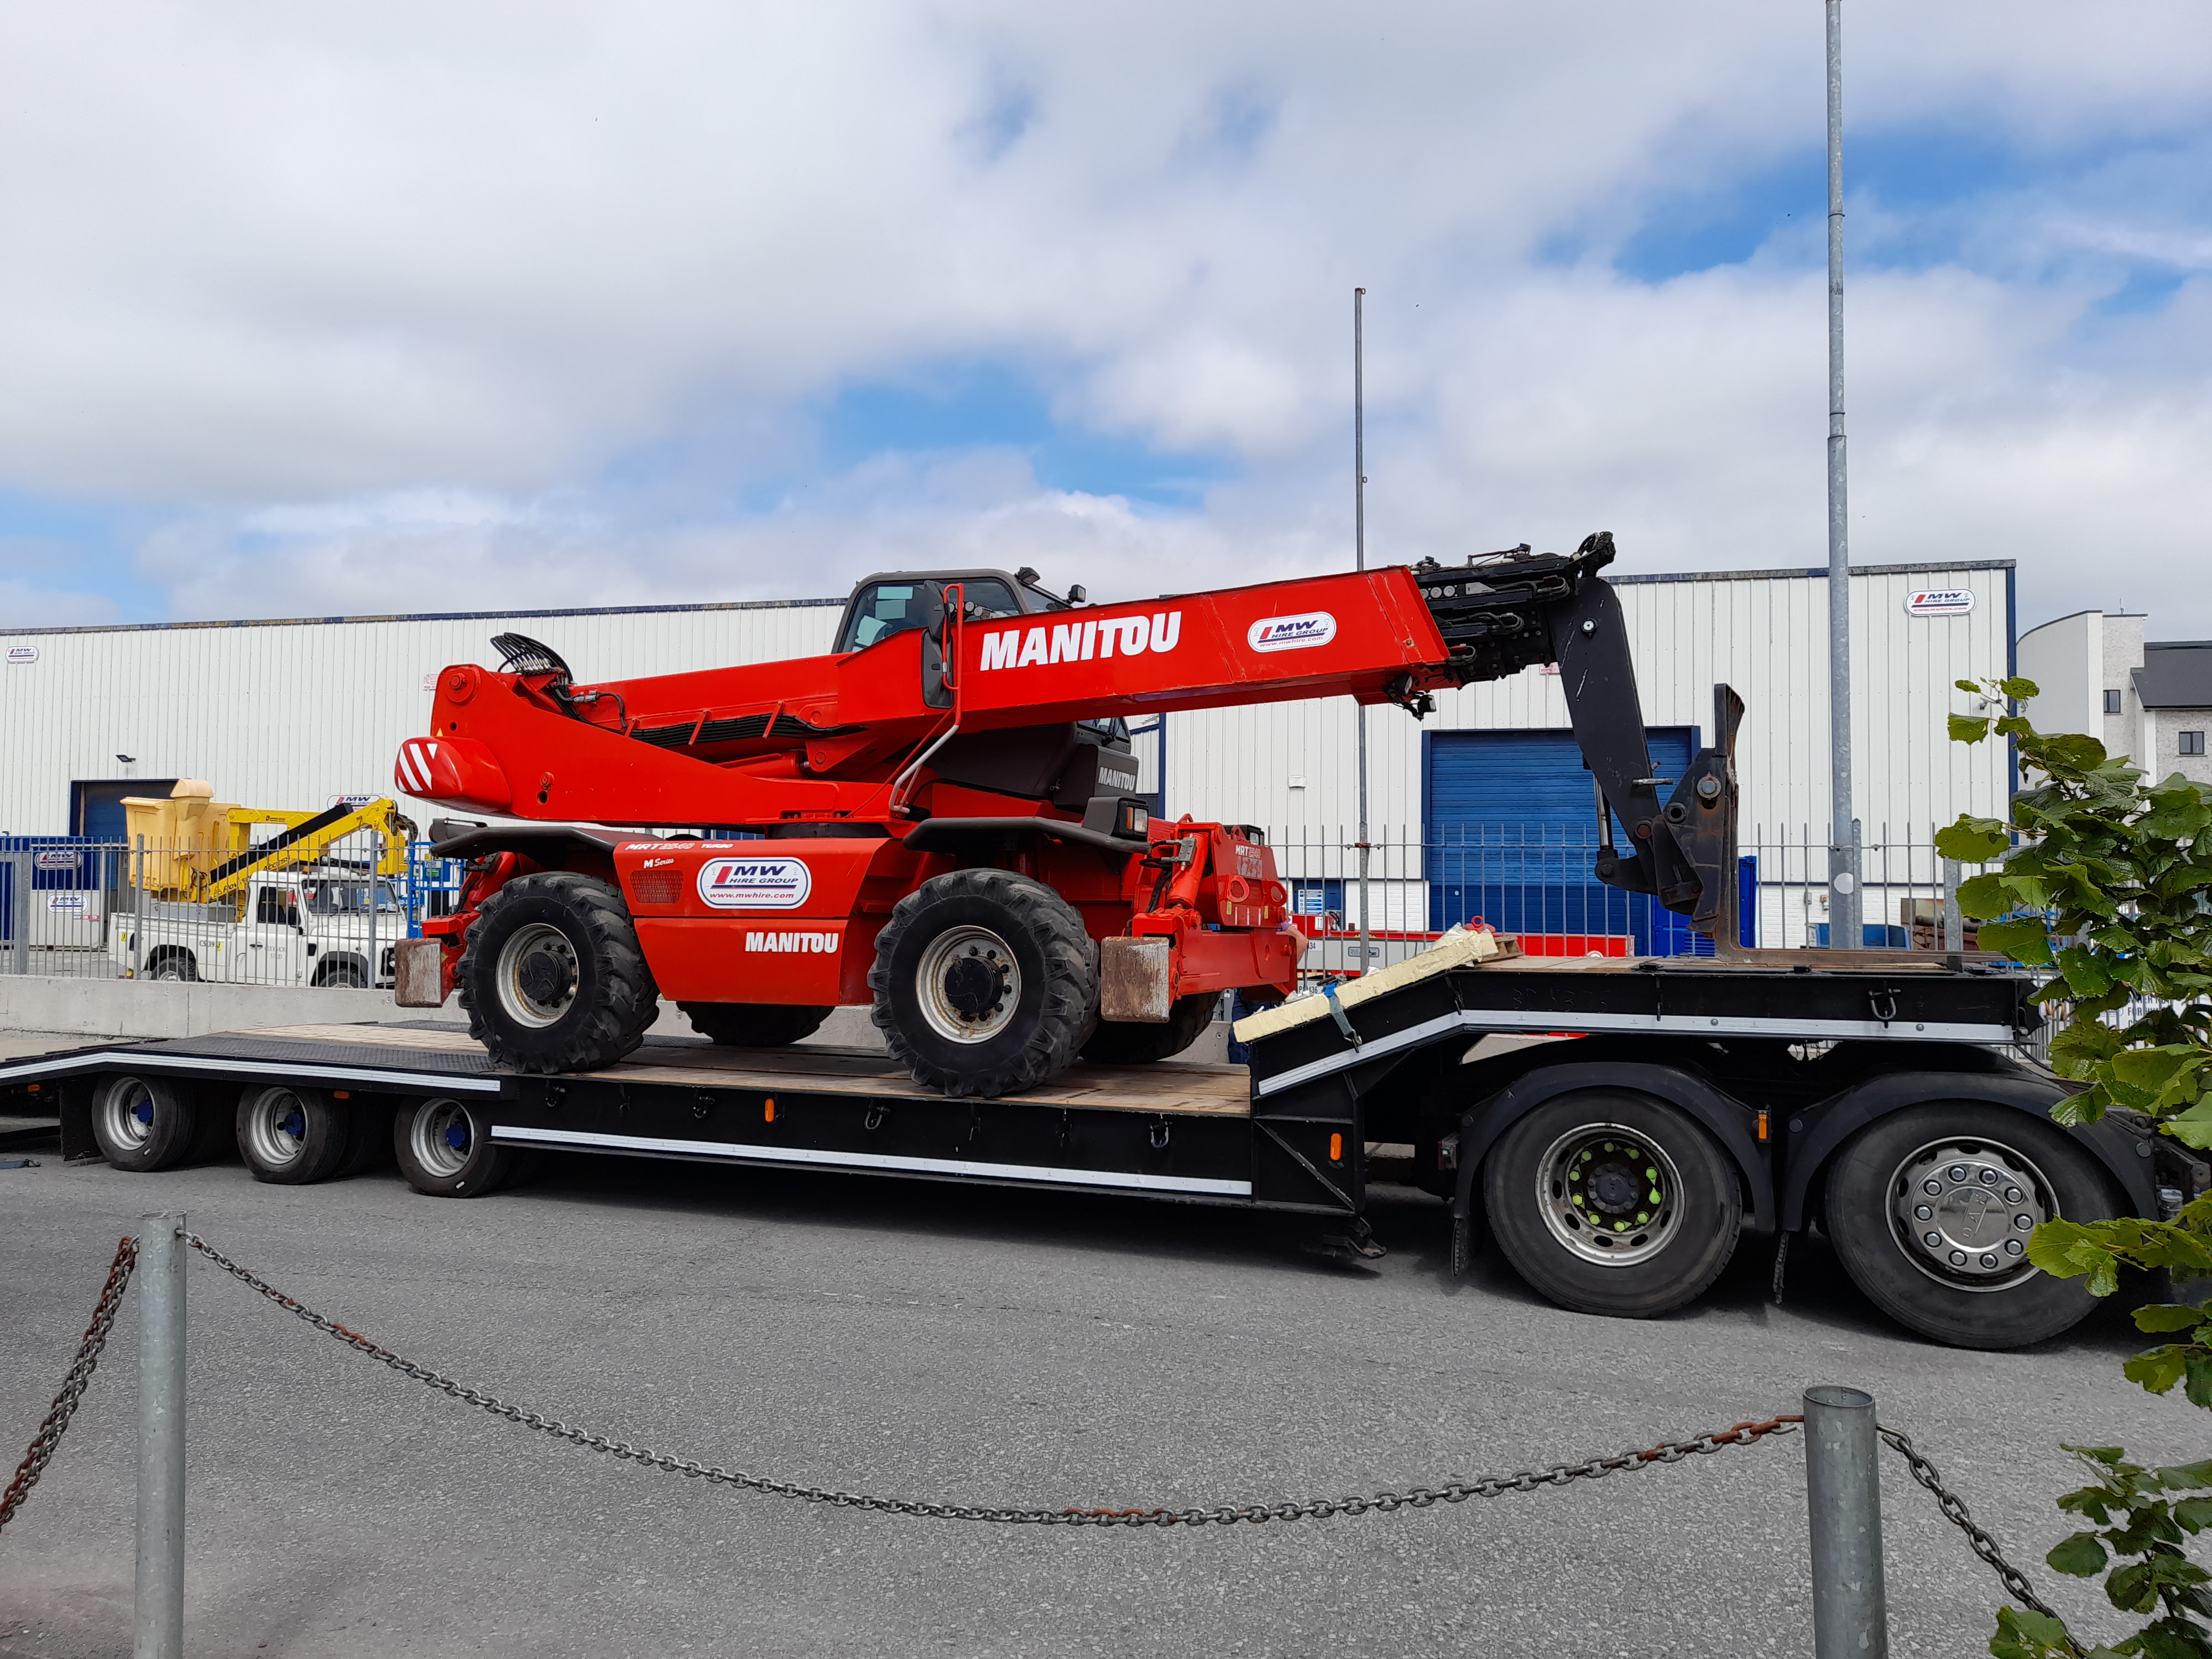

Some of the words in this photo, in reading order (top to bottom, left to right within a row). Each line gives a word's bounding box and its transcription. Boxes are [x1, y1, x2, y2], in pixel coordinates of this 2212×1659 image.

[1275, 619, 1318, 633] MW
[1296, 627, 1329, 636] GROUP
[980, 611, 1182, 671] MANITOU
[1260, 637, 1323, 648] www.mwhire.com
[1098, 766, 1136, 791] MANITOU
[643, 859, 654, 869] M
[654, 858, 674, 867] Series
[733, 865, 787, 876] MW
[745, 932, 839, 953] MANITOU
